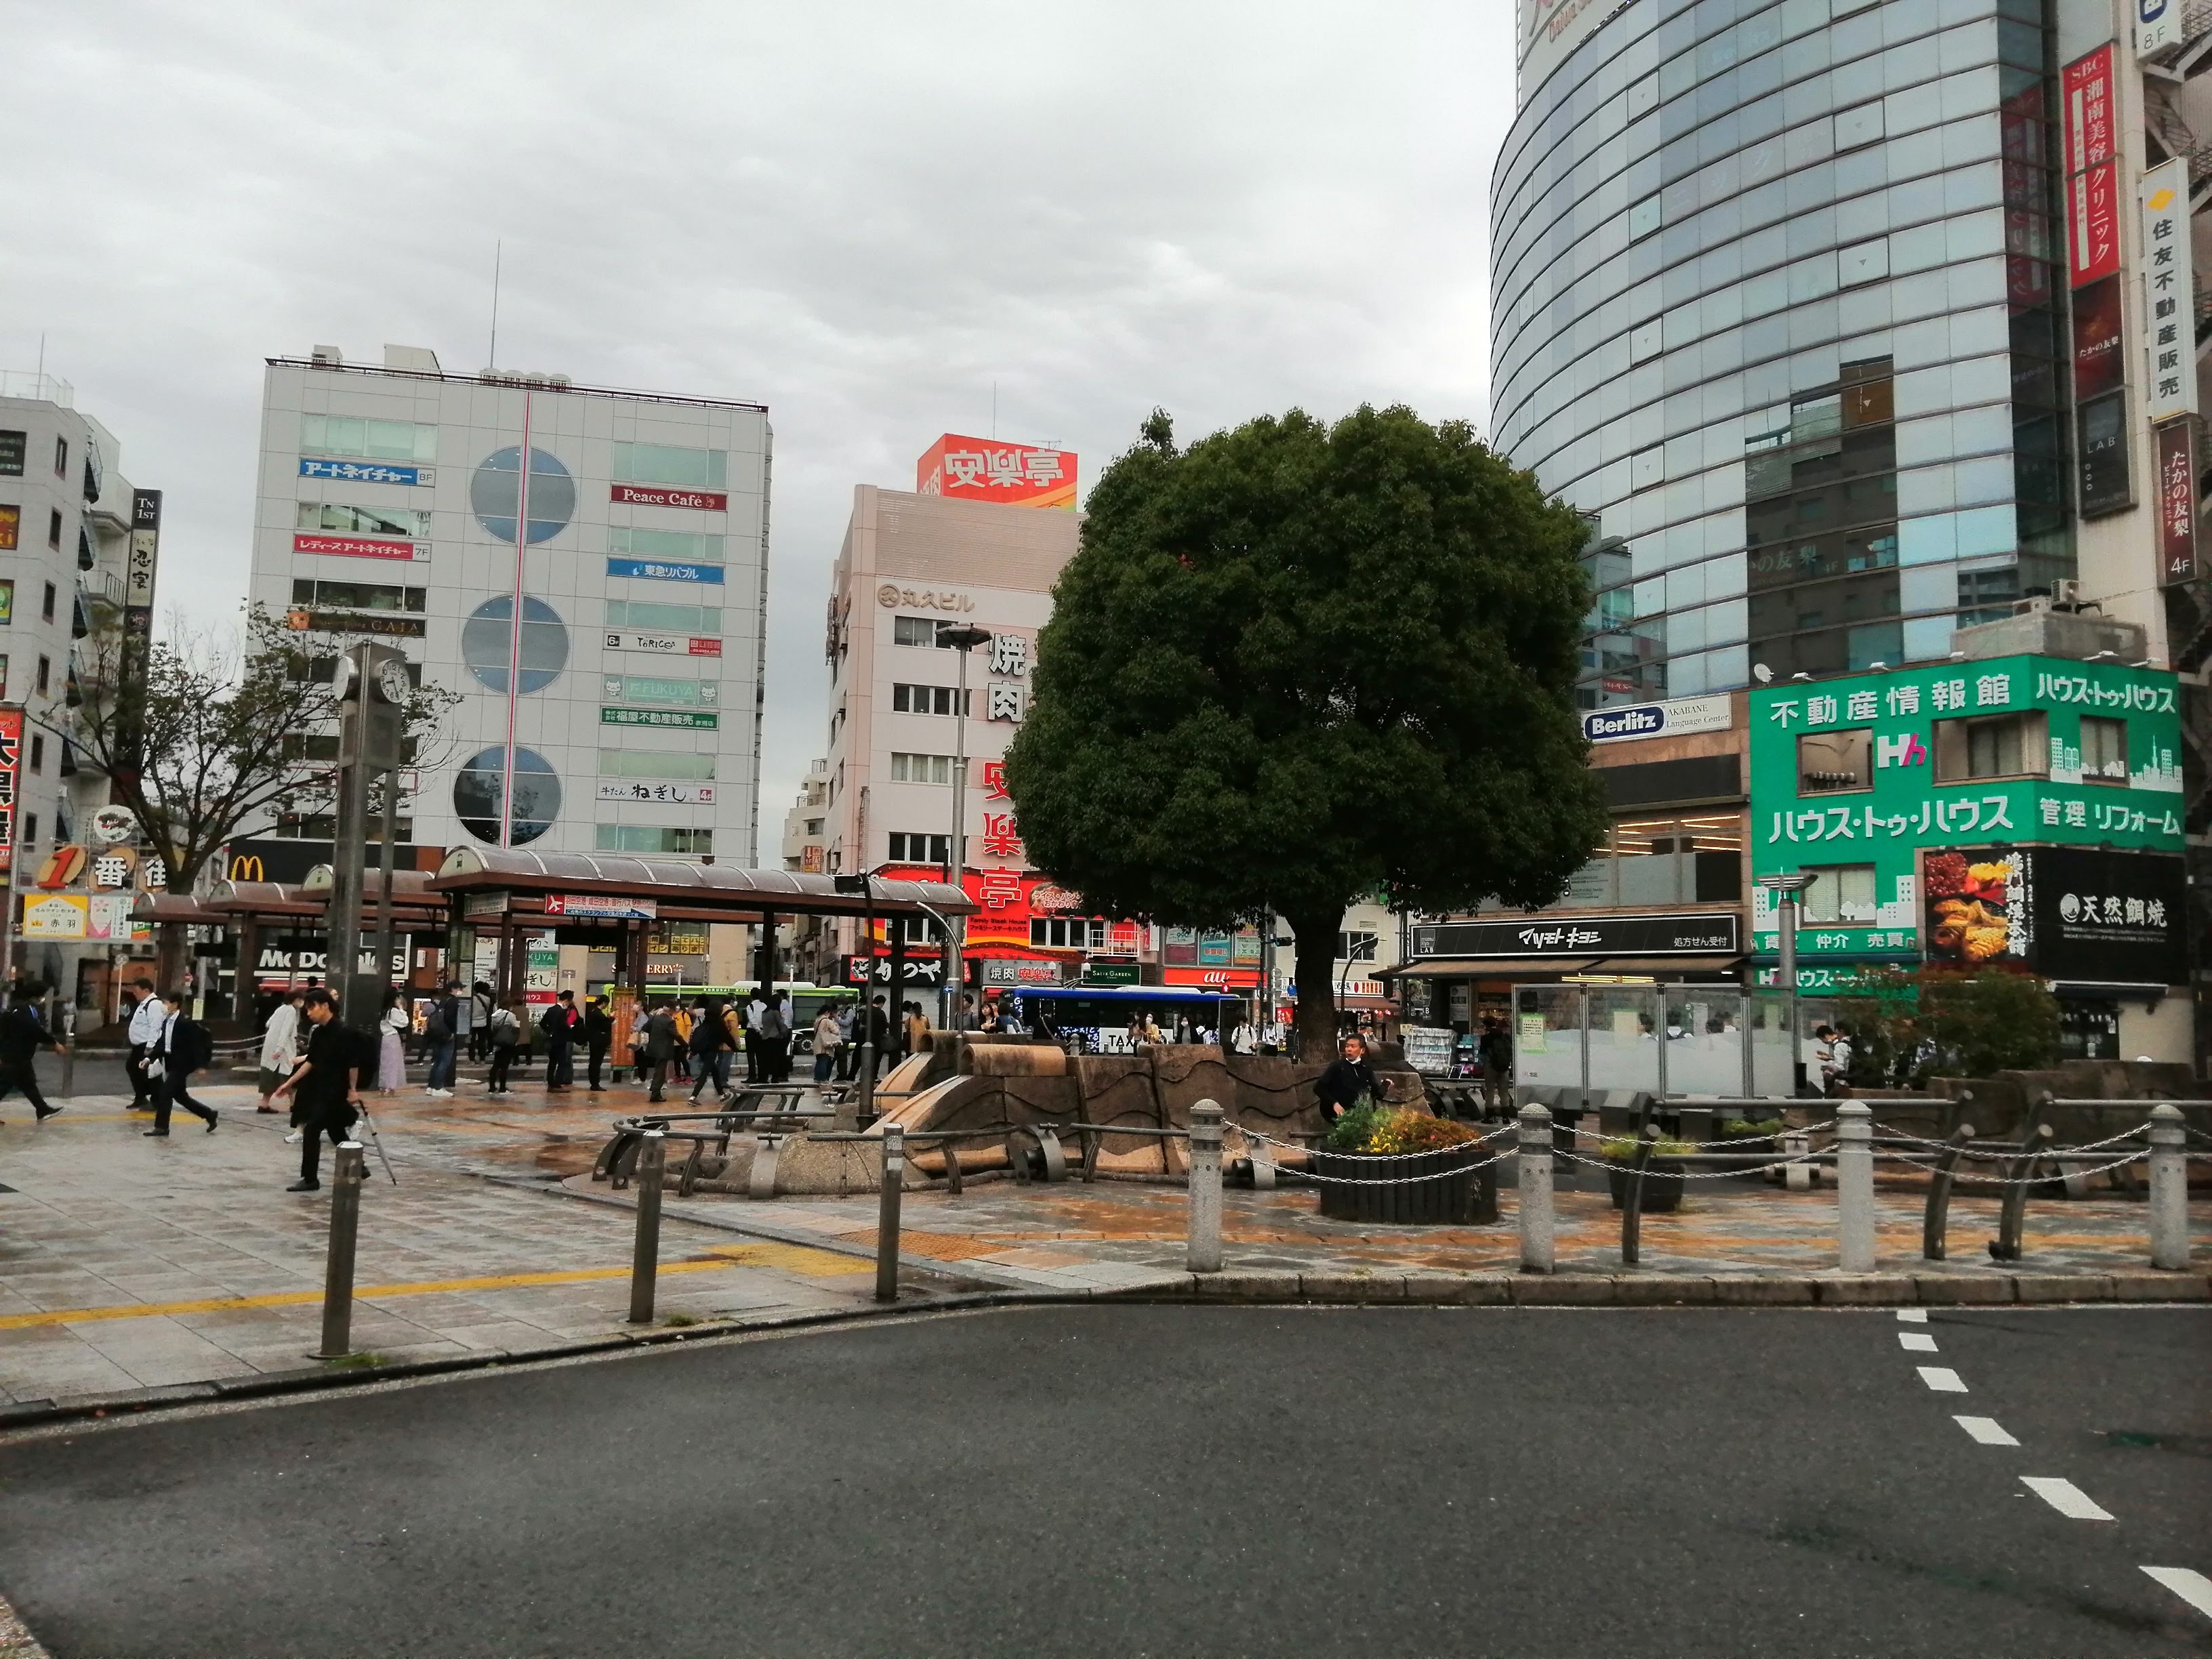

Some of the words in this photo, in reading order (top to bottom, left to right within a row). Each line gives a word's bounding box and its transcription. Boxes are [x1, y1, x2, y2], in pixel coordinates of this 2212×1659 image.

[2144, 24, 2166, 50] 8F
[2071, 54, 2104, 81] SBC
[2086, 77, 2110, 266] 湘南美容クリニック
[2152, 218, 2180, 399] 住友不動産販売
[2079, 335, 2118, 358] たかの友梨
[2087, 436, 2116, 454] LAB
[306, 461, 412, 483] アートネイチャー
[419, 473, 432, 481] 8F
[138, 497, 155, 508] TN
[623, 489, 665, 504] Peace
[668, 493, 703, 507] Café
[2171, 451, 2189, 537] たかの友梨
[137, 509, 155, 519] 1ST
[300, 539, 341, 551] レディース
[344, 542, 409, 556] アートネイチャー
[415, 547, 428, 556] 7F
[644, 564, 699, 579] 東急リバブル
[2170, 556, 2190, 574] 4F
[901, 588, 975, 613] 丸久ビル
[607, 636, 619, 646] 6F
[987, 632, 1027, 722] 焼肉
[1770, 673, 2011, 729] 不動産情報館
[2036, 674, 2176, 714] ハウス・トゥ・ハウス
[616, 710, 694, 726] 福屋不動産販売
[1593, 710, 1656, 735] Berlitz
[1668, 704, 1708, 716] AKABANE
[1666, 716, 1702, 729] Language
[1704, 714, 1729, 724] Center
[601, 786, 626, 796] 牛たん
[631, 783, 687, 802] ねぎし
[699, 790, 712, 801] 4F
[1769, 796, 2013, 844] ハウス・トゥ・ハウス
[2040, 798, 2087, 827] 管理
[2095, 804, 2181, 835] リフォーム
[2082, 895, 2167, 928] 天然鯛焼
[51, 918, 76, 928] 赤羽
[1673, 936, 1727, 947] 処方せん受付
[1816, 933, 1849, 949] 仲介
[1867, 932, 1904, 947] 売買
[990, 966, 1015, 981] 焼肉
[1204, 971, 1229, 984] au
